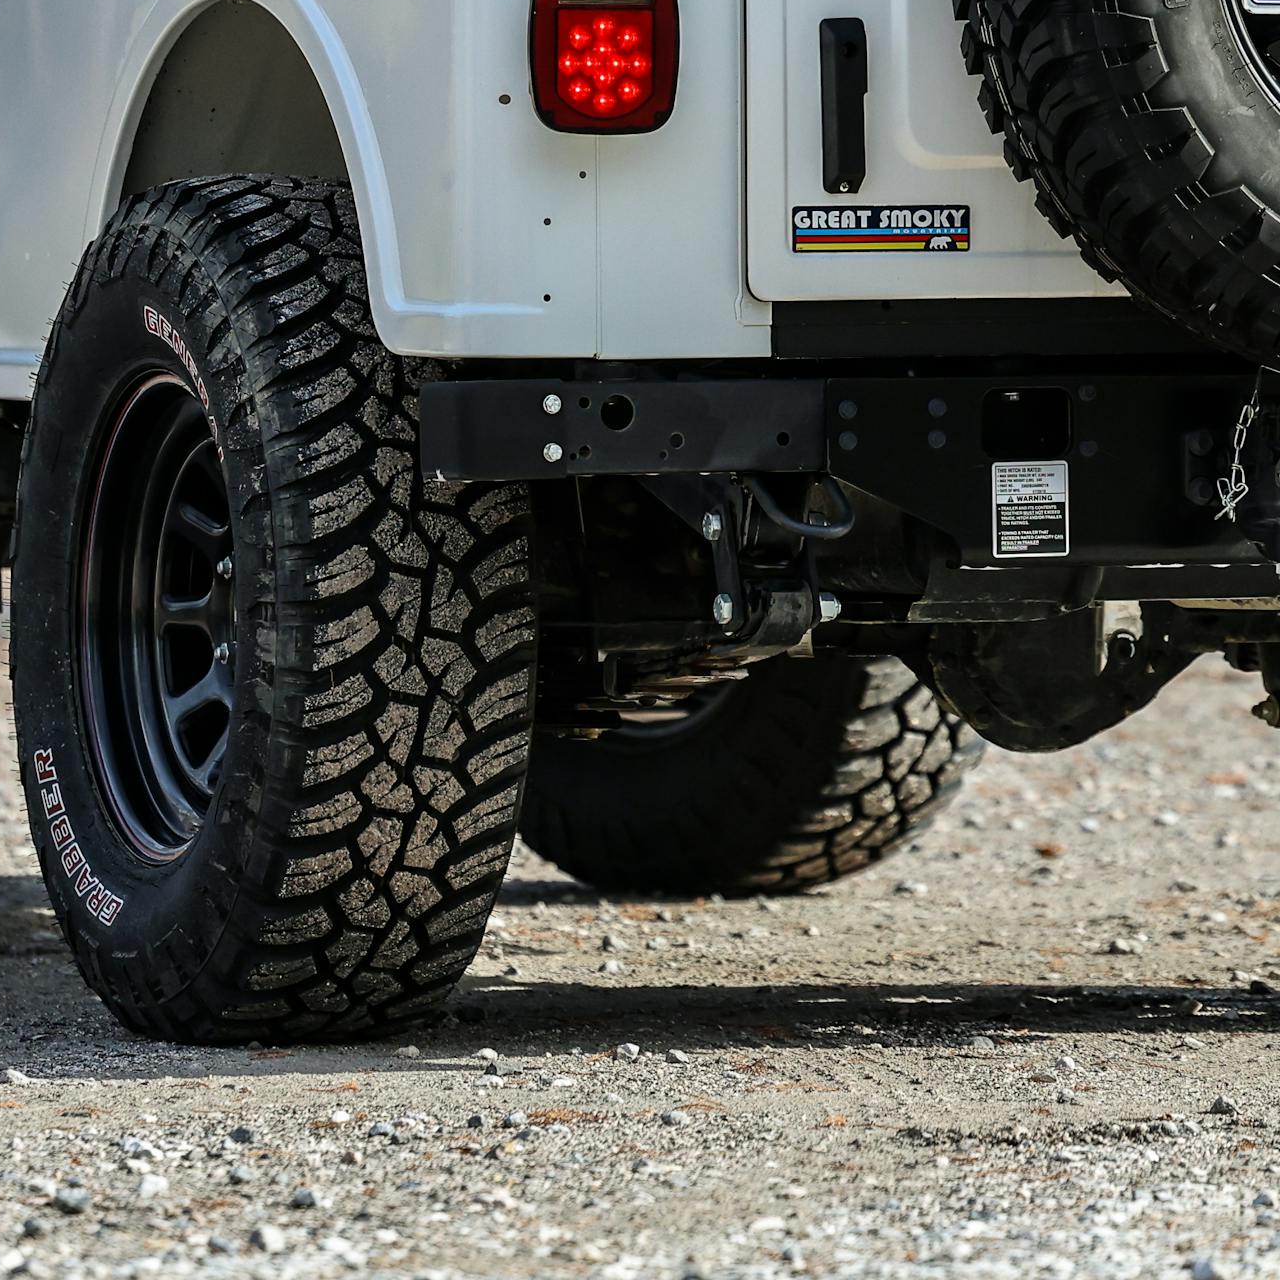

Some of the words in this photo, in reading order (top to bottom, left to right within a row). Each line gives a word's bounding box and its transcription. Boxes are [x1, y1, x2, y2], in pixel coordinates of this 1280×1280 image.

[794, 210, 872, 229] GREAT
[879, 209, 966, 228] SMOKY
[33, 747, 124, 927] GRABBER
